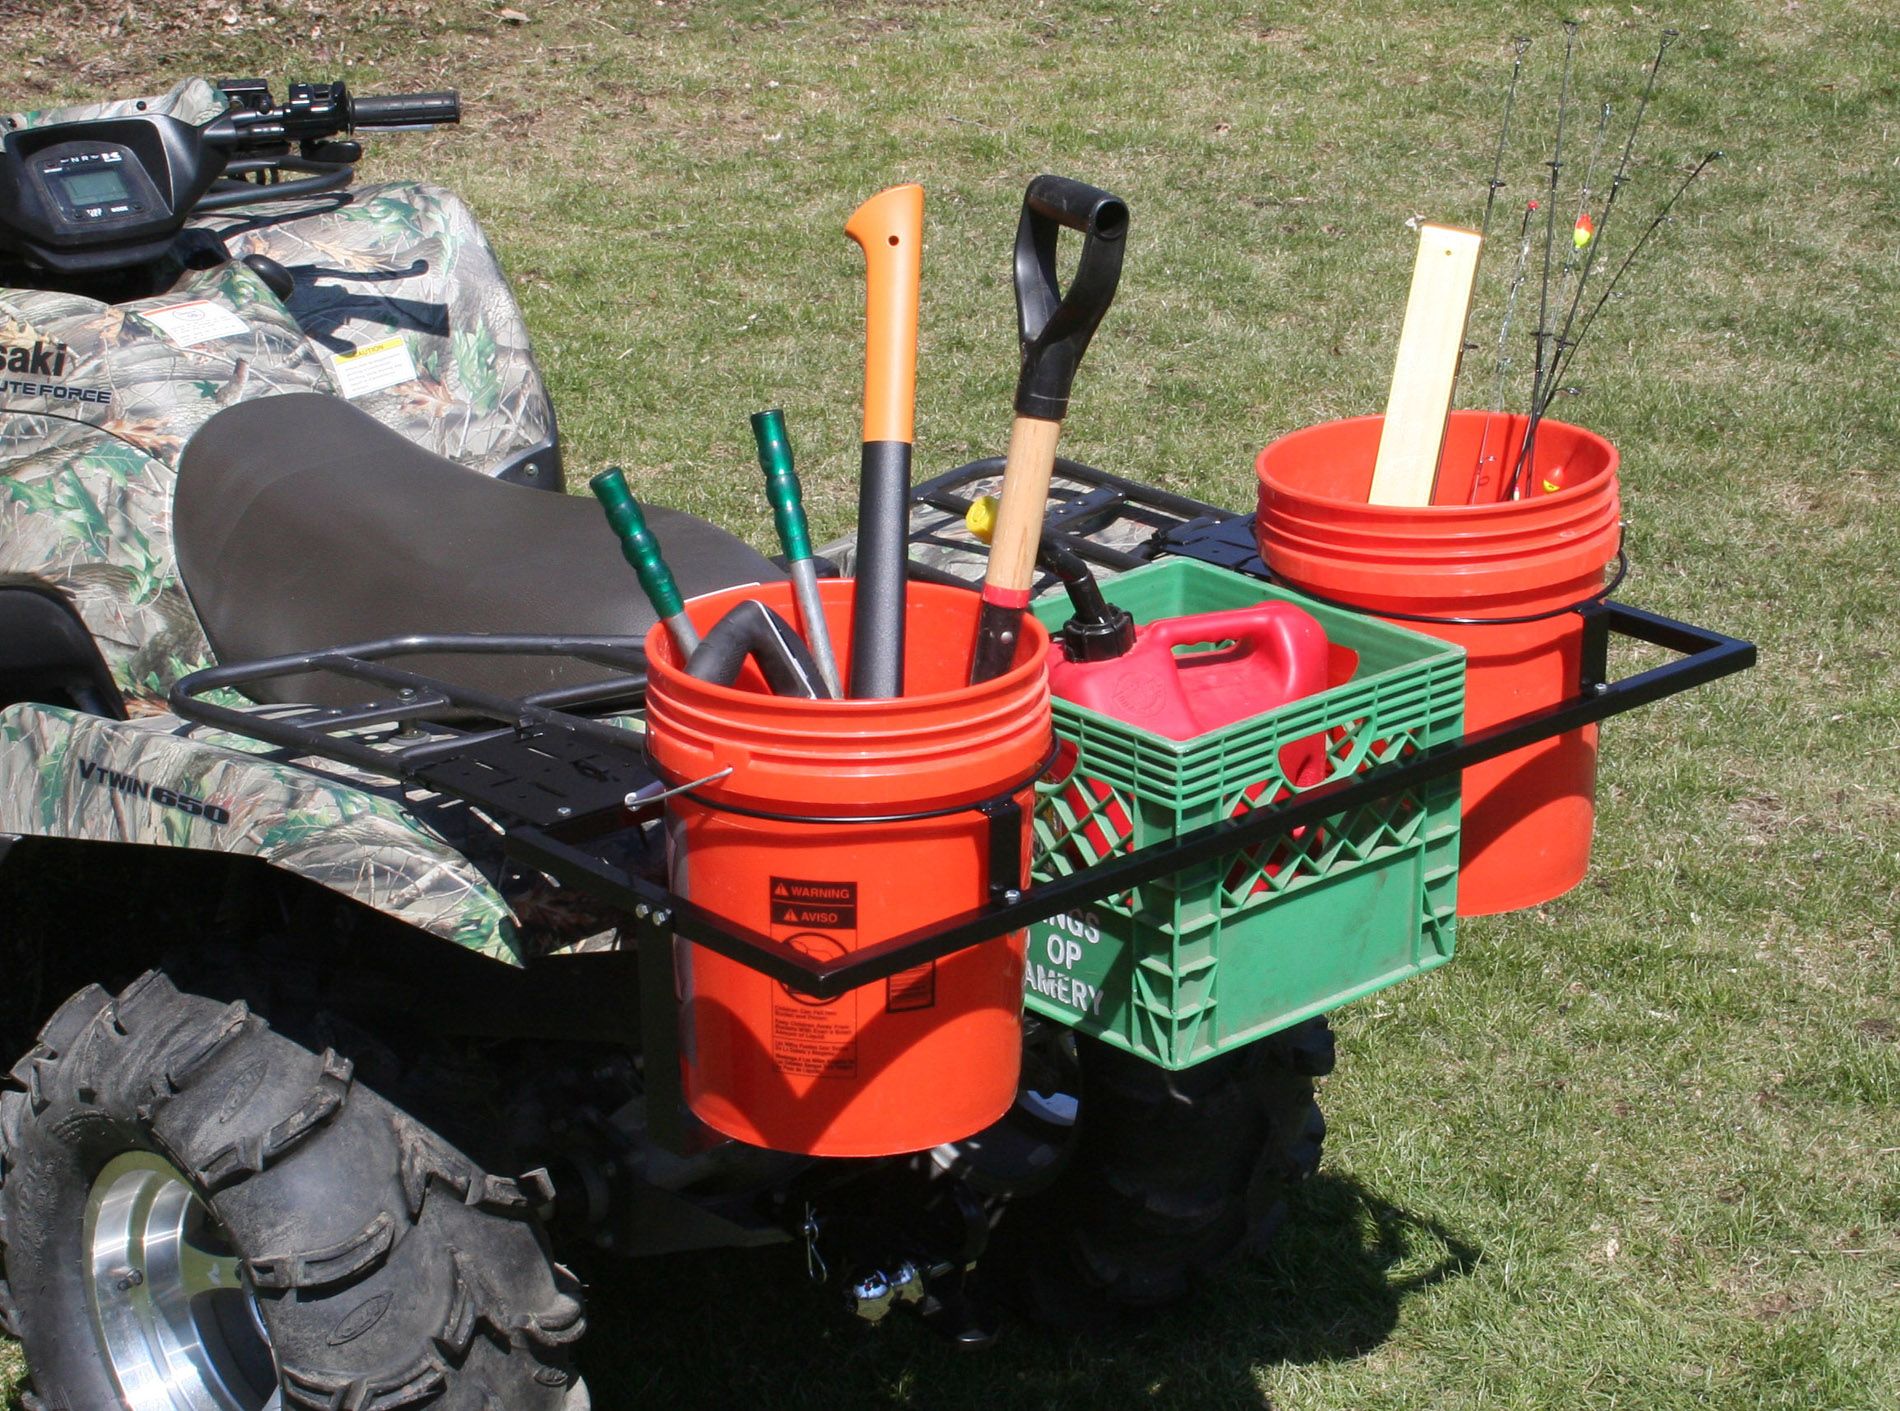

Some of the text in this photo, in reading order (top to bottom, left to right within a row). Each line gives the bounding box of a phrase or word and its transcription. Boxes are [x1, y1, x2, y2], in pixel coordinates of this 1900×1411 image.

[40, 384, 112, 404] FORCE
[151, 787, 230, 825] 650
[791, 885, 850, 899] WARNING
[801, 911, 838, 924] AVISO
[1047, 934, 1082, 970] OP
